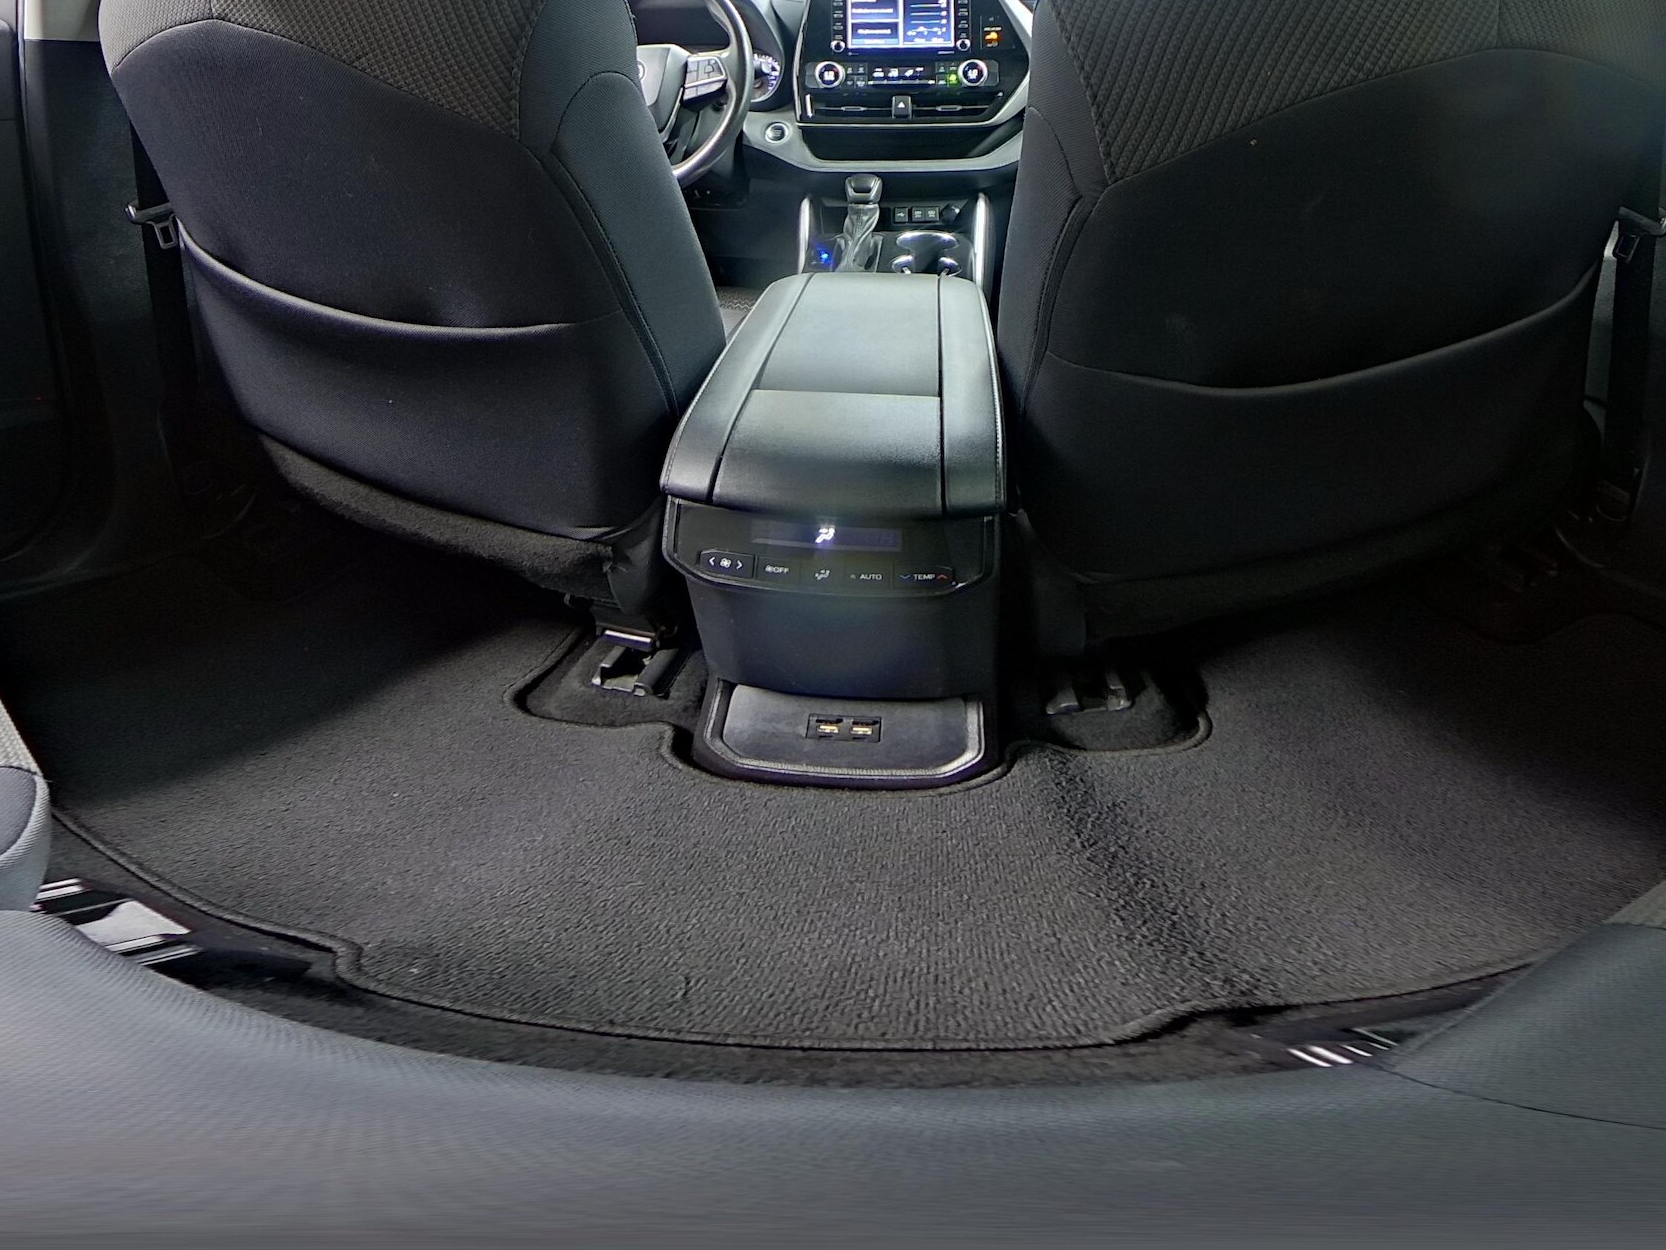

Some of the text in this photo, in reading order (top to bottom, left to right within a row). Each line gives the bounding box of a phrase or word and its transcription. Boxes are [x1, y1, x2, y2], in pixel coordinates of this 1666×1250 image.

[773, 566, 789, 574] OFF
[860, 573, 883, 581] AUTO
[914, 573, 935, 581] TEMP
